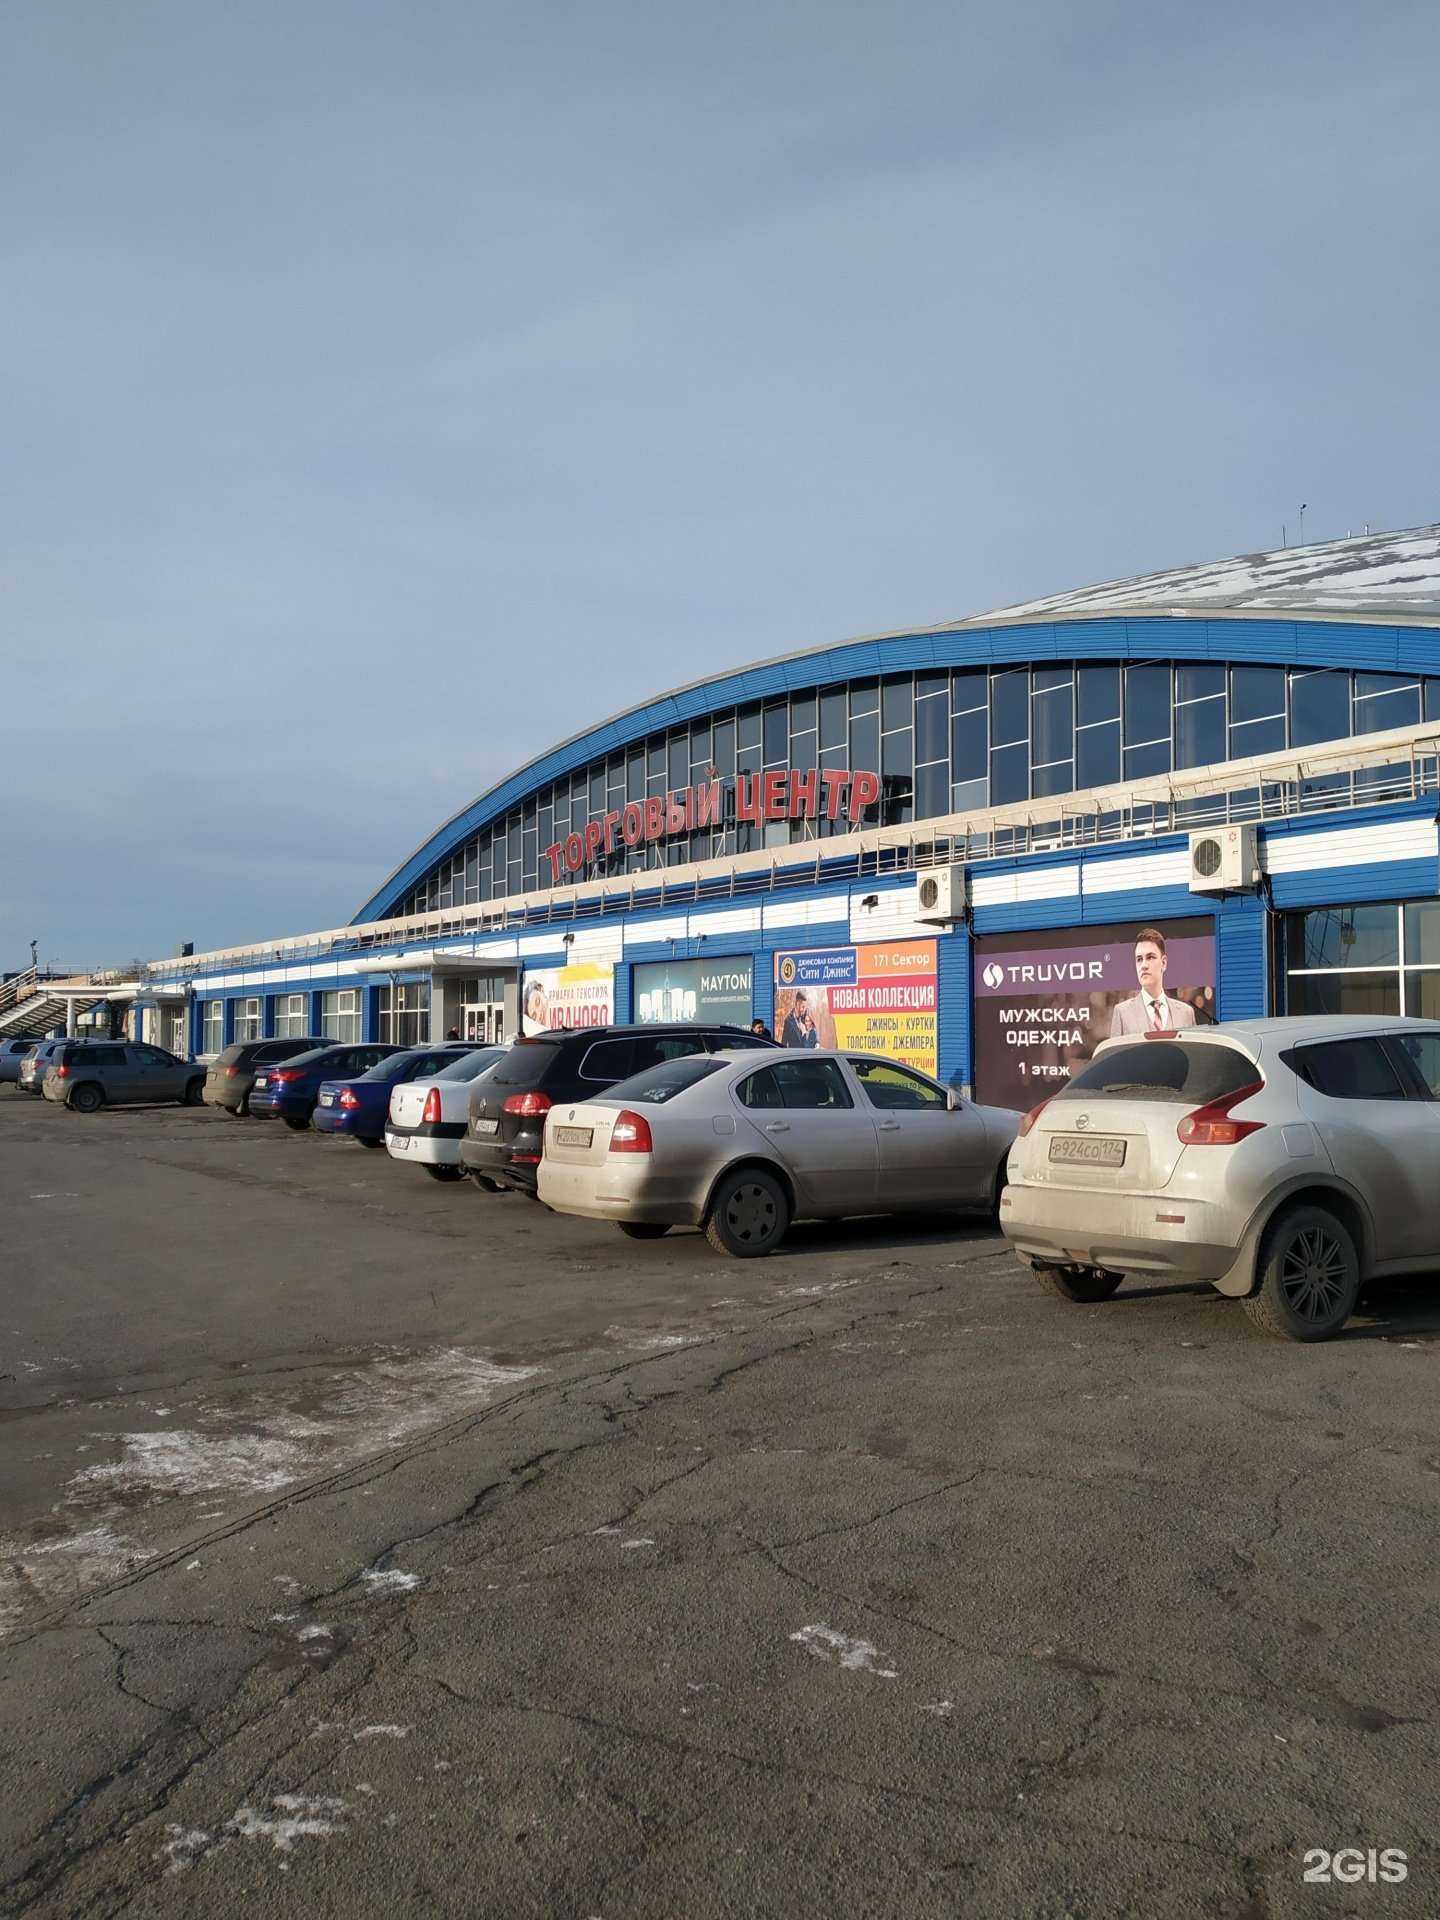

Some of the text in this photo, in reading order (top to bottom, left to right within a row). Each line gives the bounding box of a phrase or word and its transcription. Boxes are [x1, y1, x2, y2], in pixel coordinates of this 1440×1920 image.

[546, 765, 882, 881] ТОРГОВЫЙ ЦЕНТР
[873, 952, 930, 968] 171 Сектор
[833, 986, 935, 1011] НОВАЯ КОЛЛЕКЦИЯ
[1000, 1007, 1090, 1024] МУЖСКАЯ
[867, 1017, 935, 1032] ДЖИНСЫ КУРТКИ
[847, 1035, 935, 1050] ТОЛСТОВКИ ДЖЕМПЕРА
[1006, 1029, 1083, 1047] ОДЕЖДА
[1018, 1062, 1070, 1076] 1 этаж
